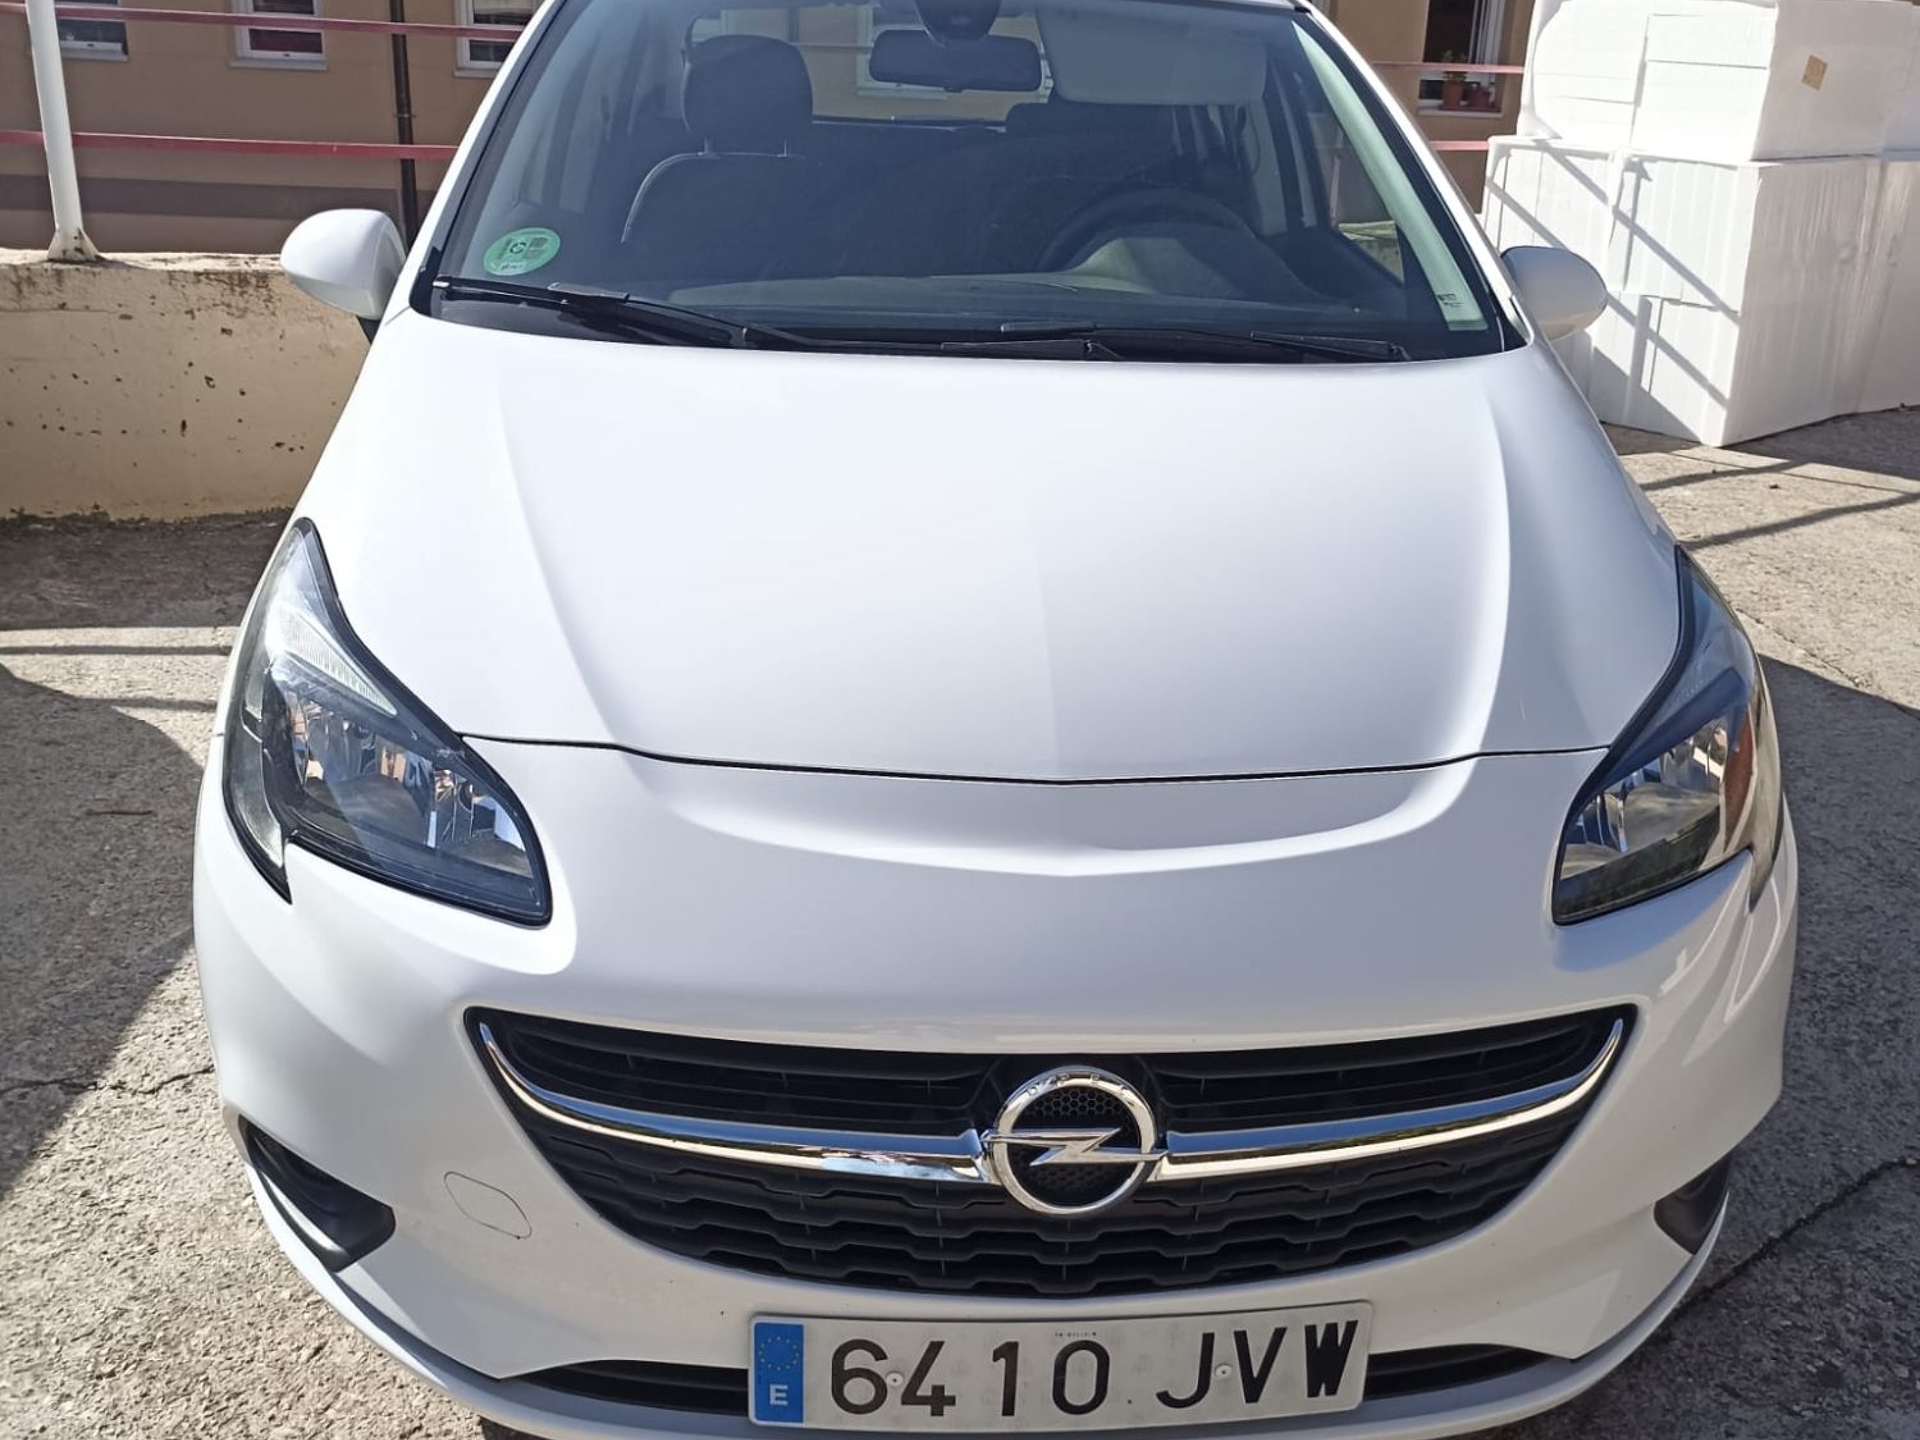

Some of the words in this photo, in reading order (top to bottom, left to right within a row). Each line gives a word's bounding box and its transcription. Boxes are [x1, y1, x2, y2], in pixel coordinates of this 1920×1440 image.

[769, 1383, 789, 1407] E
[830, 1338, 1111, 1417] 6410
[1156, 1319, 1359, 1409] JVW
